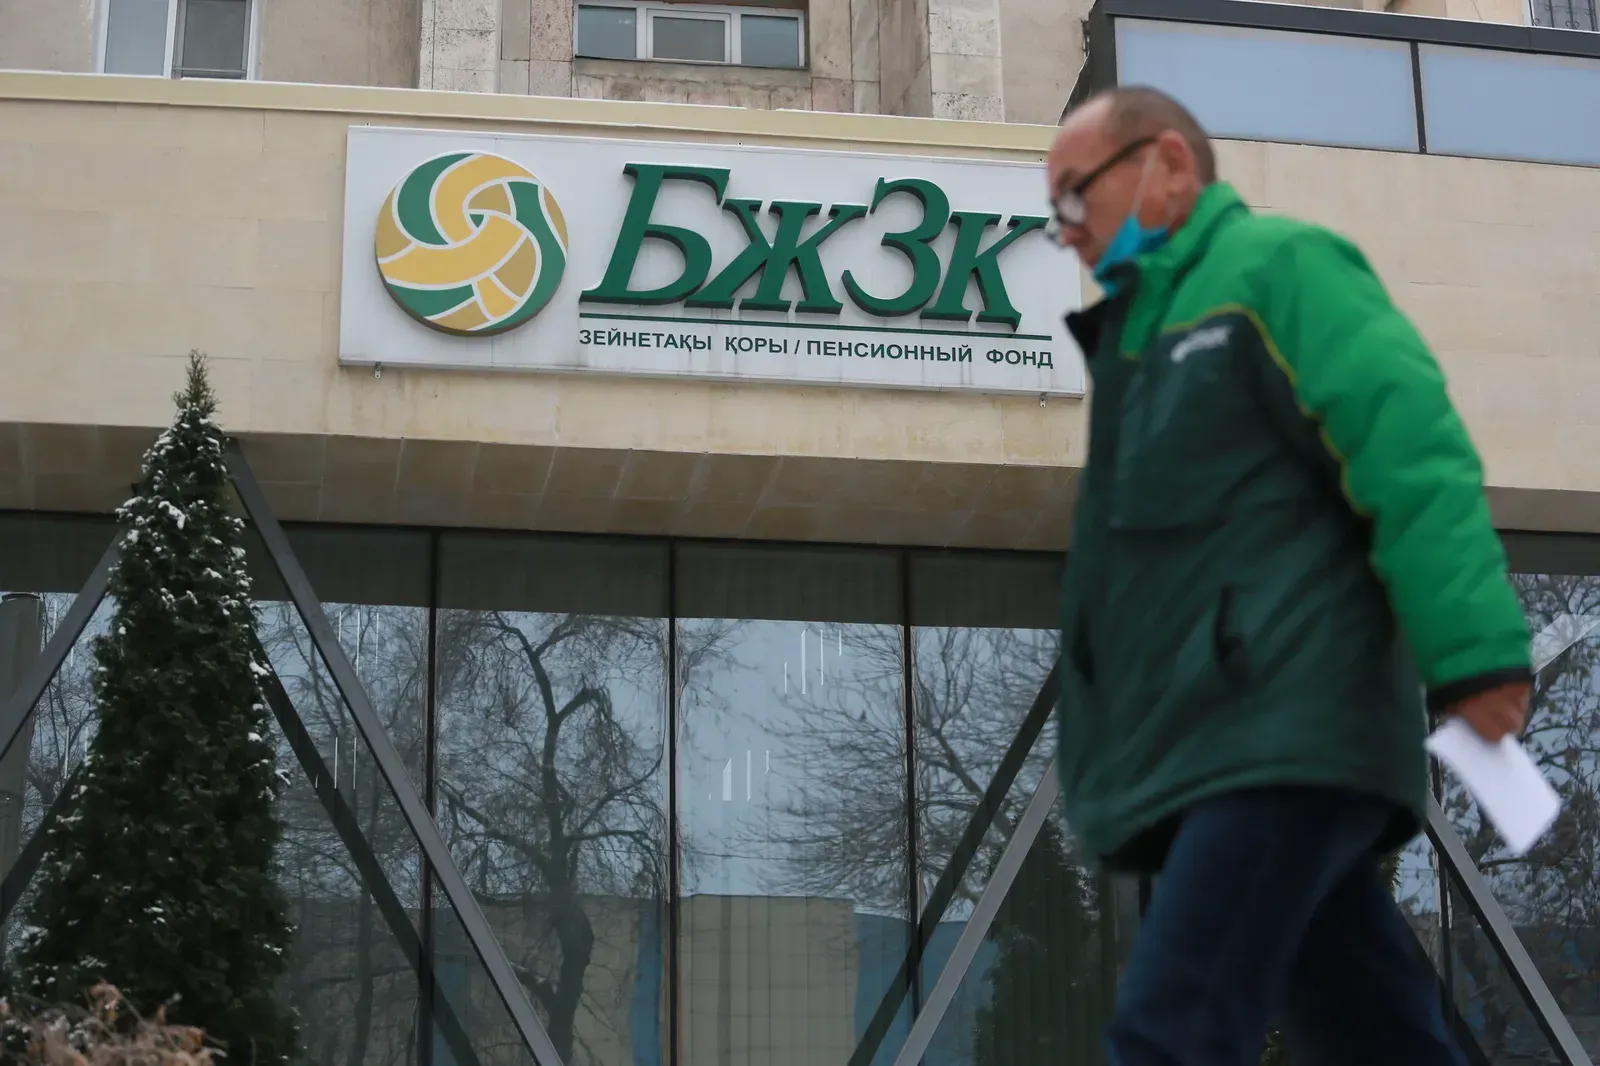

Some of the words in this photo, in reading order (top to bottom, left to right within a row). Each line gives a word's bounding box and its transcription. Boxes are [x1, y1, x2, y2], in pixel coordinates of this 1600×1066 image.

[579, 328, 711, 352] ЗЕЙНЕТАҚЫ
[725, 336, 787, 354] ҚОРЫ
[806, 340, 972, 363] ПЕНСИОННЫЙ
[986, 349, 1053, 369] ФОНД
